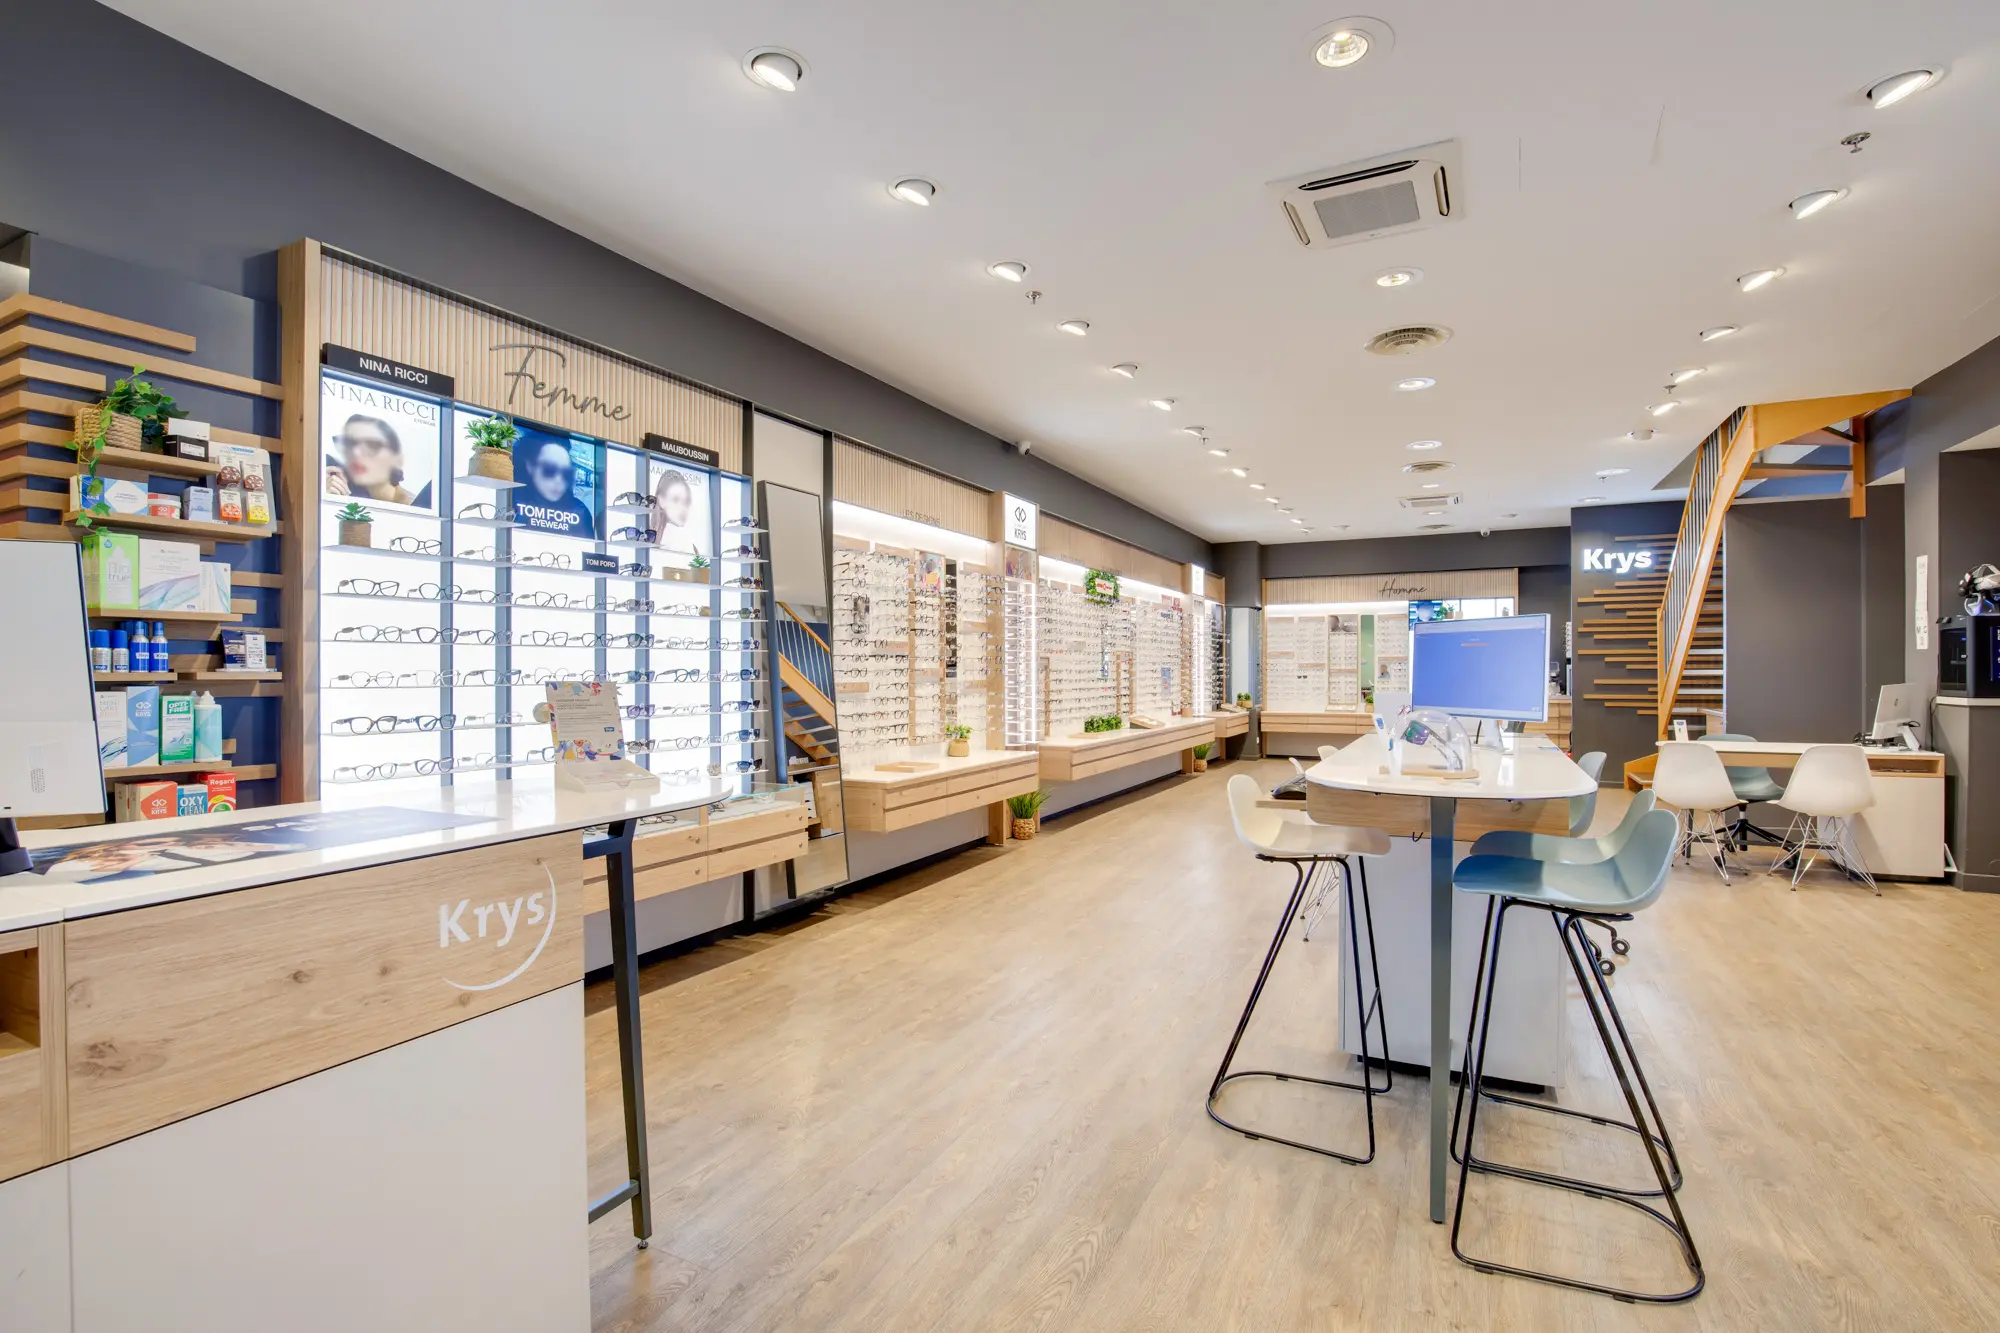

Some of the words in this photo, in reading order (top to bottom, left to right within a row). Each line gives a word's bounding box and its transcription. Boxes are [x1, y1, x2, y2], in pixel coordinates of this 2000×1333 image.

[359, 357, 391, 375] NINA
[394, 366, 428, 385] RICCI
[490, 344, 632, 421] Femme
[322, 381, 378, 407] NINA
[382, 395, 436, 421] RICCI
[661, 441, 709, 462] MAUBOUSSIN
[516, 503, 545, 519] TOM
[547, 508, 580, 525] FORD
[530, 518, 569, 531] EYEWEAR
[586, 558, 599, 567] TOM
[599, 560, 616, 568] FORD
[1582, 547, 1653, 574] Krys
[1378, 578, 1428, 598] Homme
[210, 778, 235, 786] Regard
[179, 795, 204, 807] OXY
[179, 804, 205, 817] CLEAN
[439, 892, 545, 948] Krys
